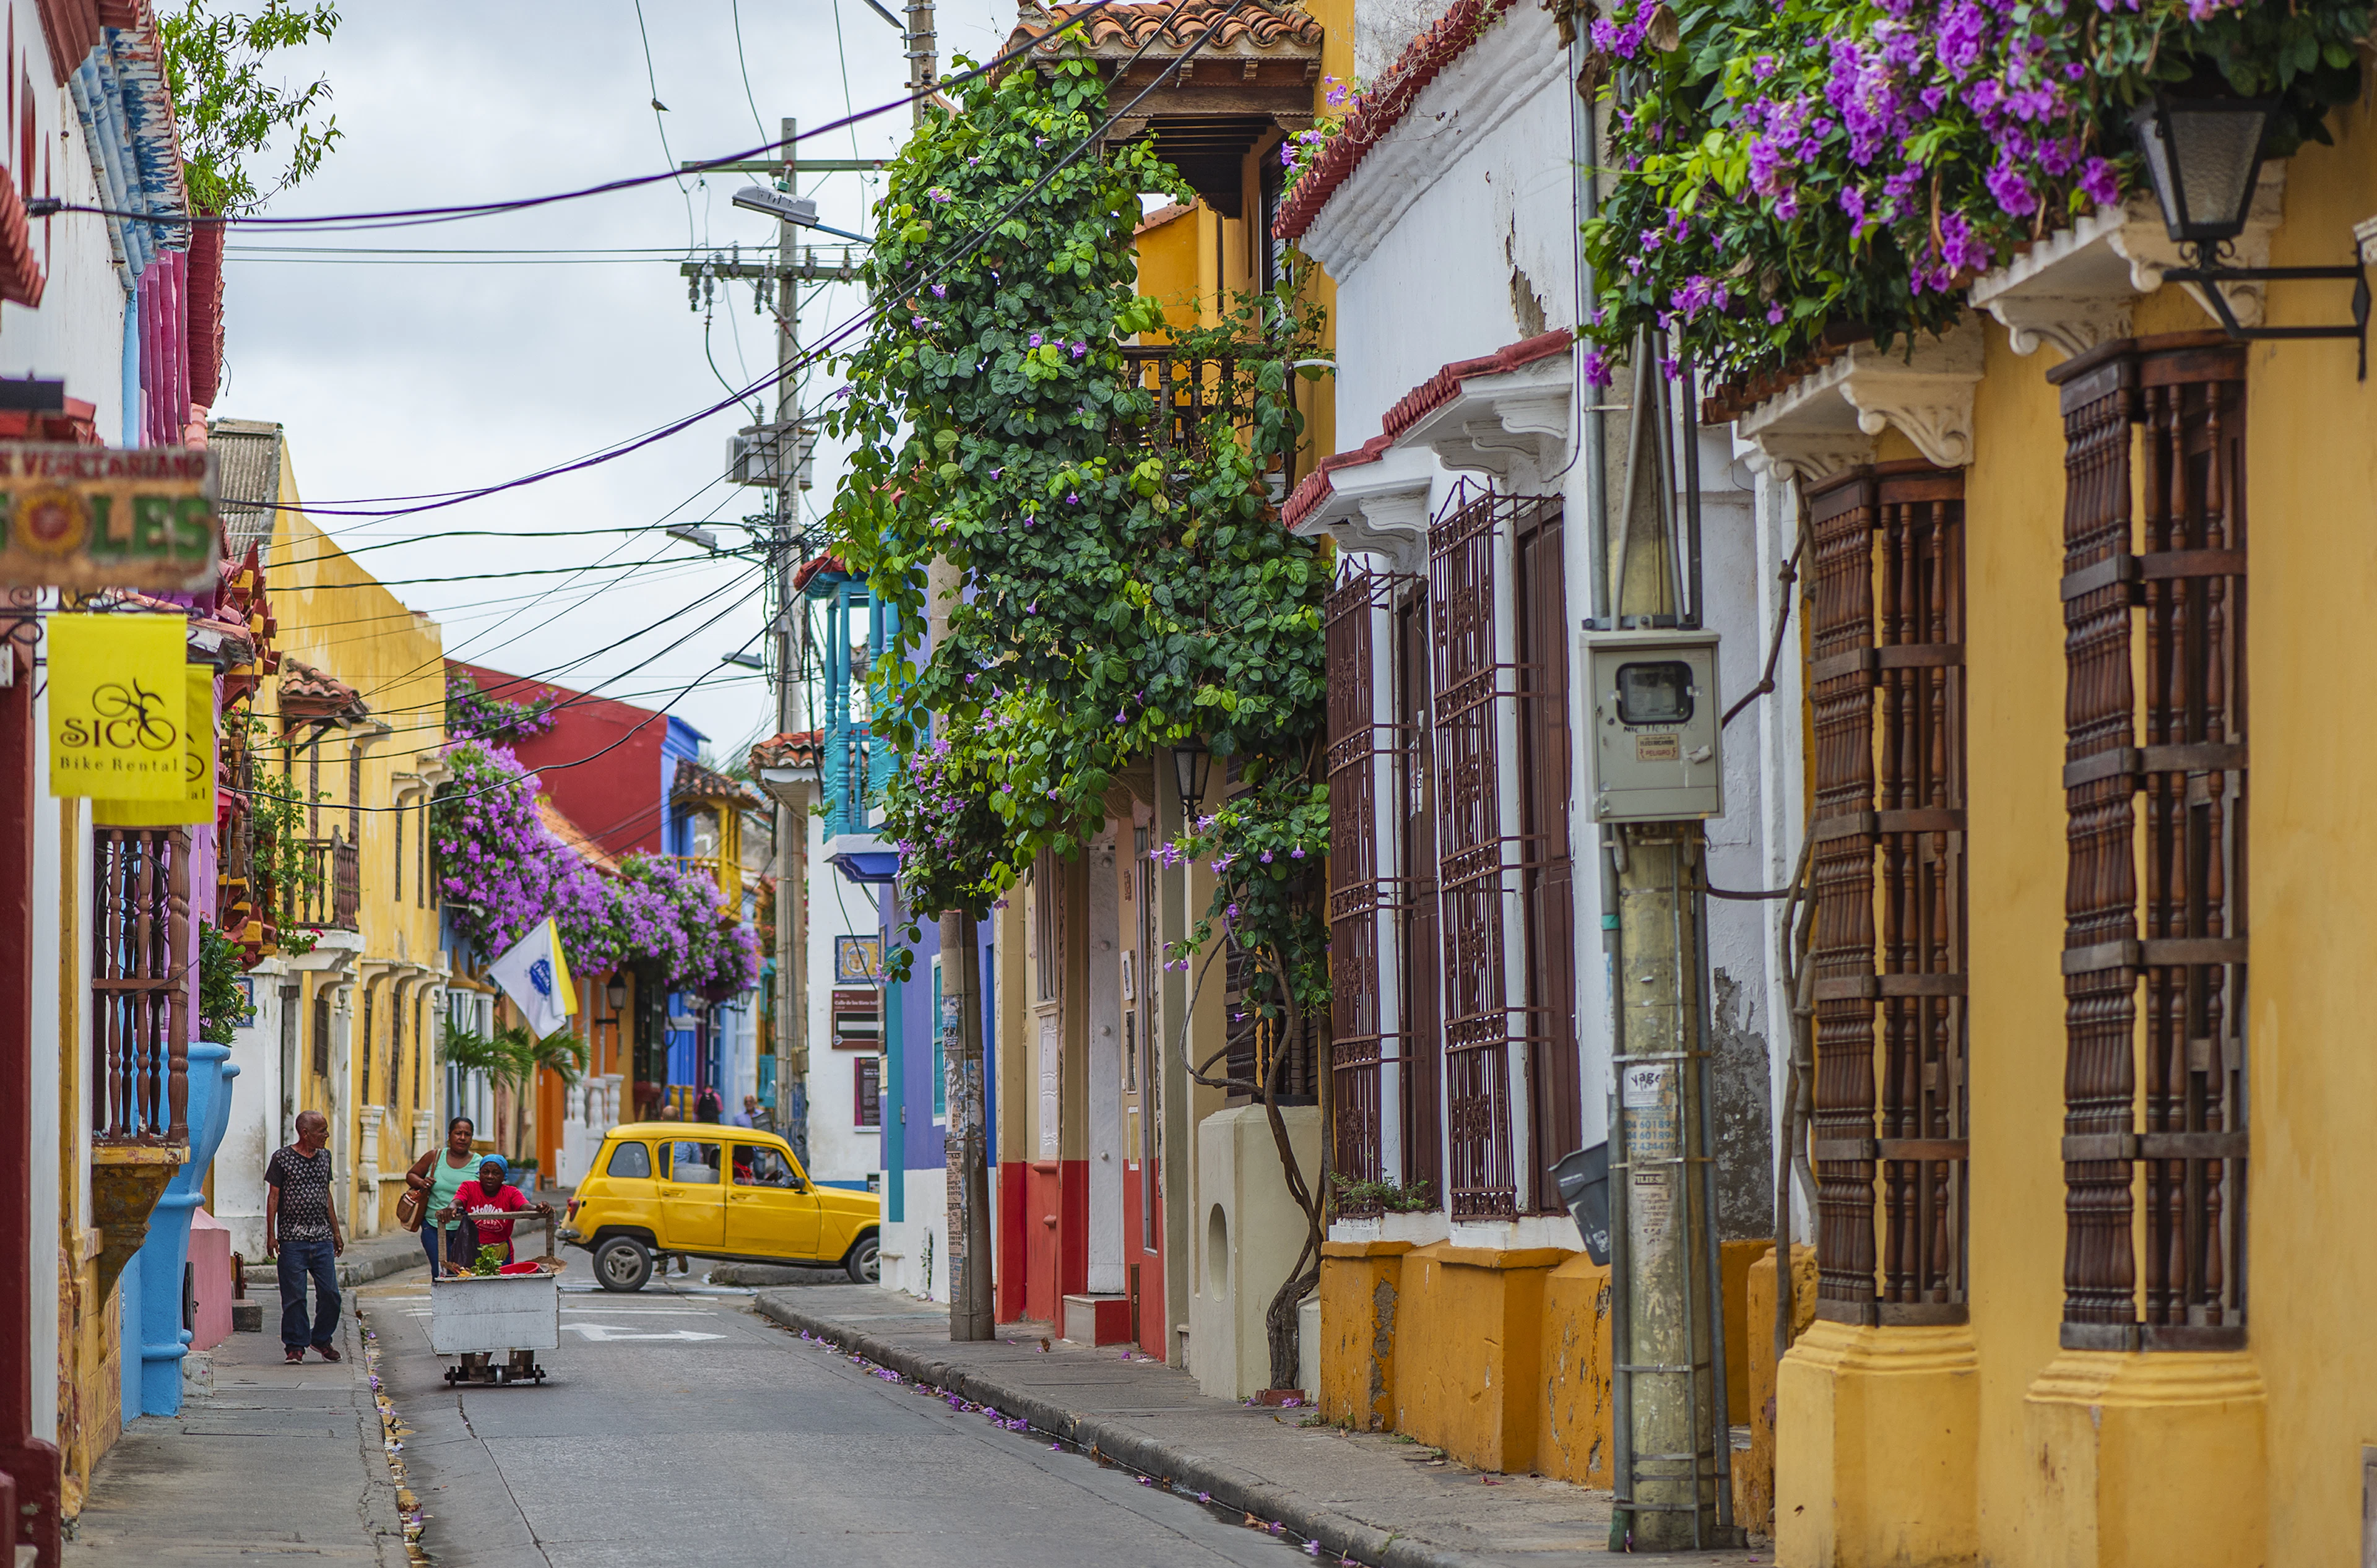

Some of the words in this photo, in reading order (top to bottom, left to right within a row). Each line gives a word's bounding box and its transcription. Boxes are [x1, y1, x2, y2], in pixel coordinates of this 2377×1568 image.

[60, 718, 176, 751] SICO
[60, 756, 103, 770] Bike
[112, 756, 178, 772] Rental
